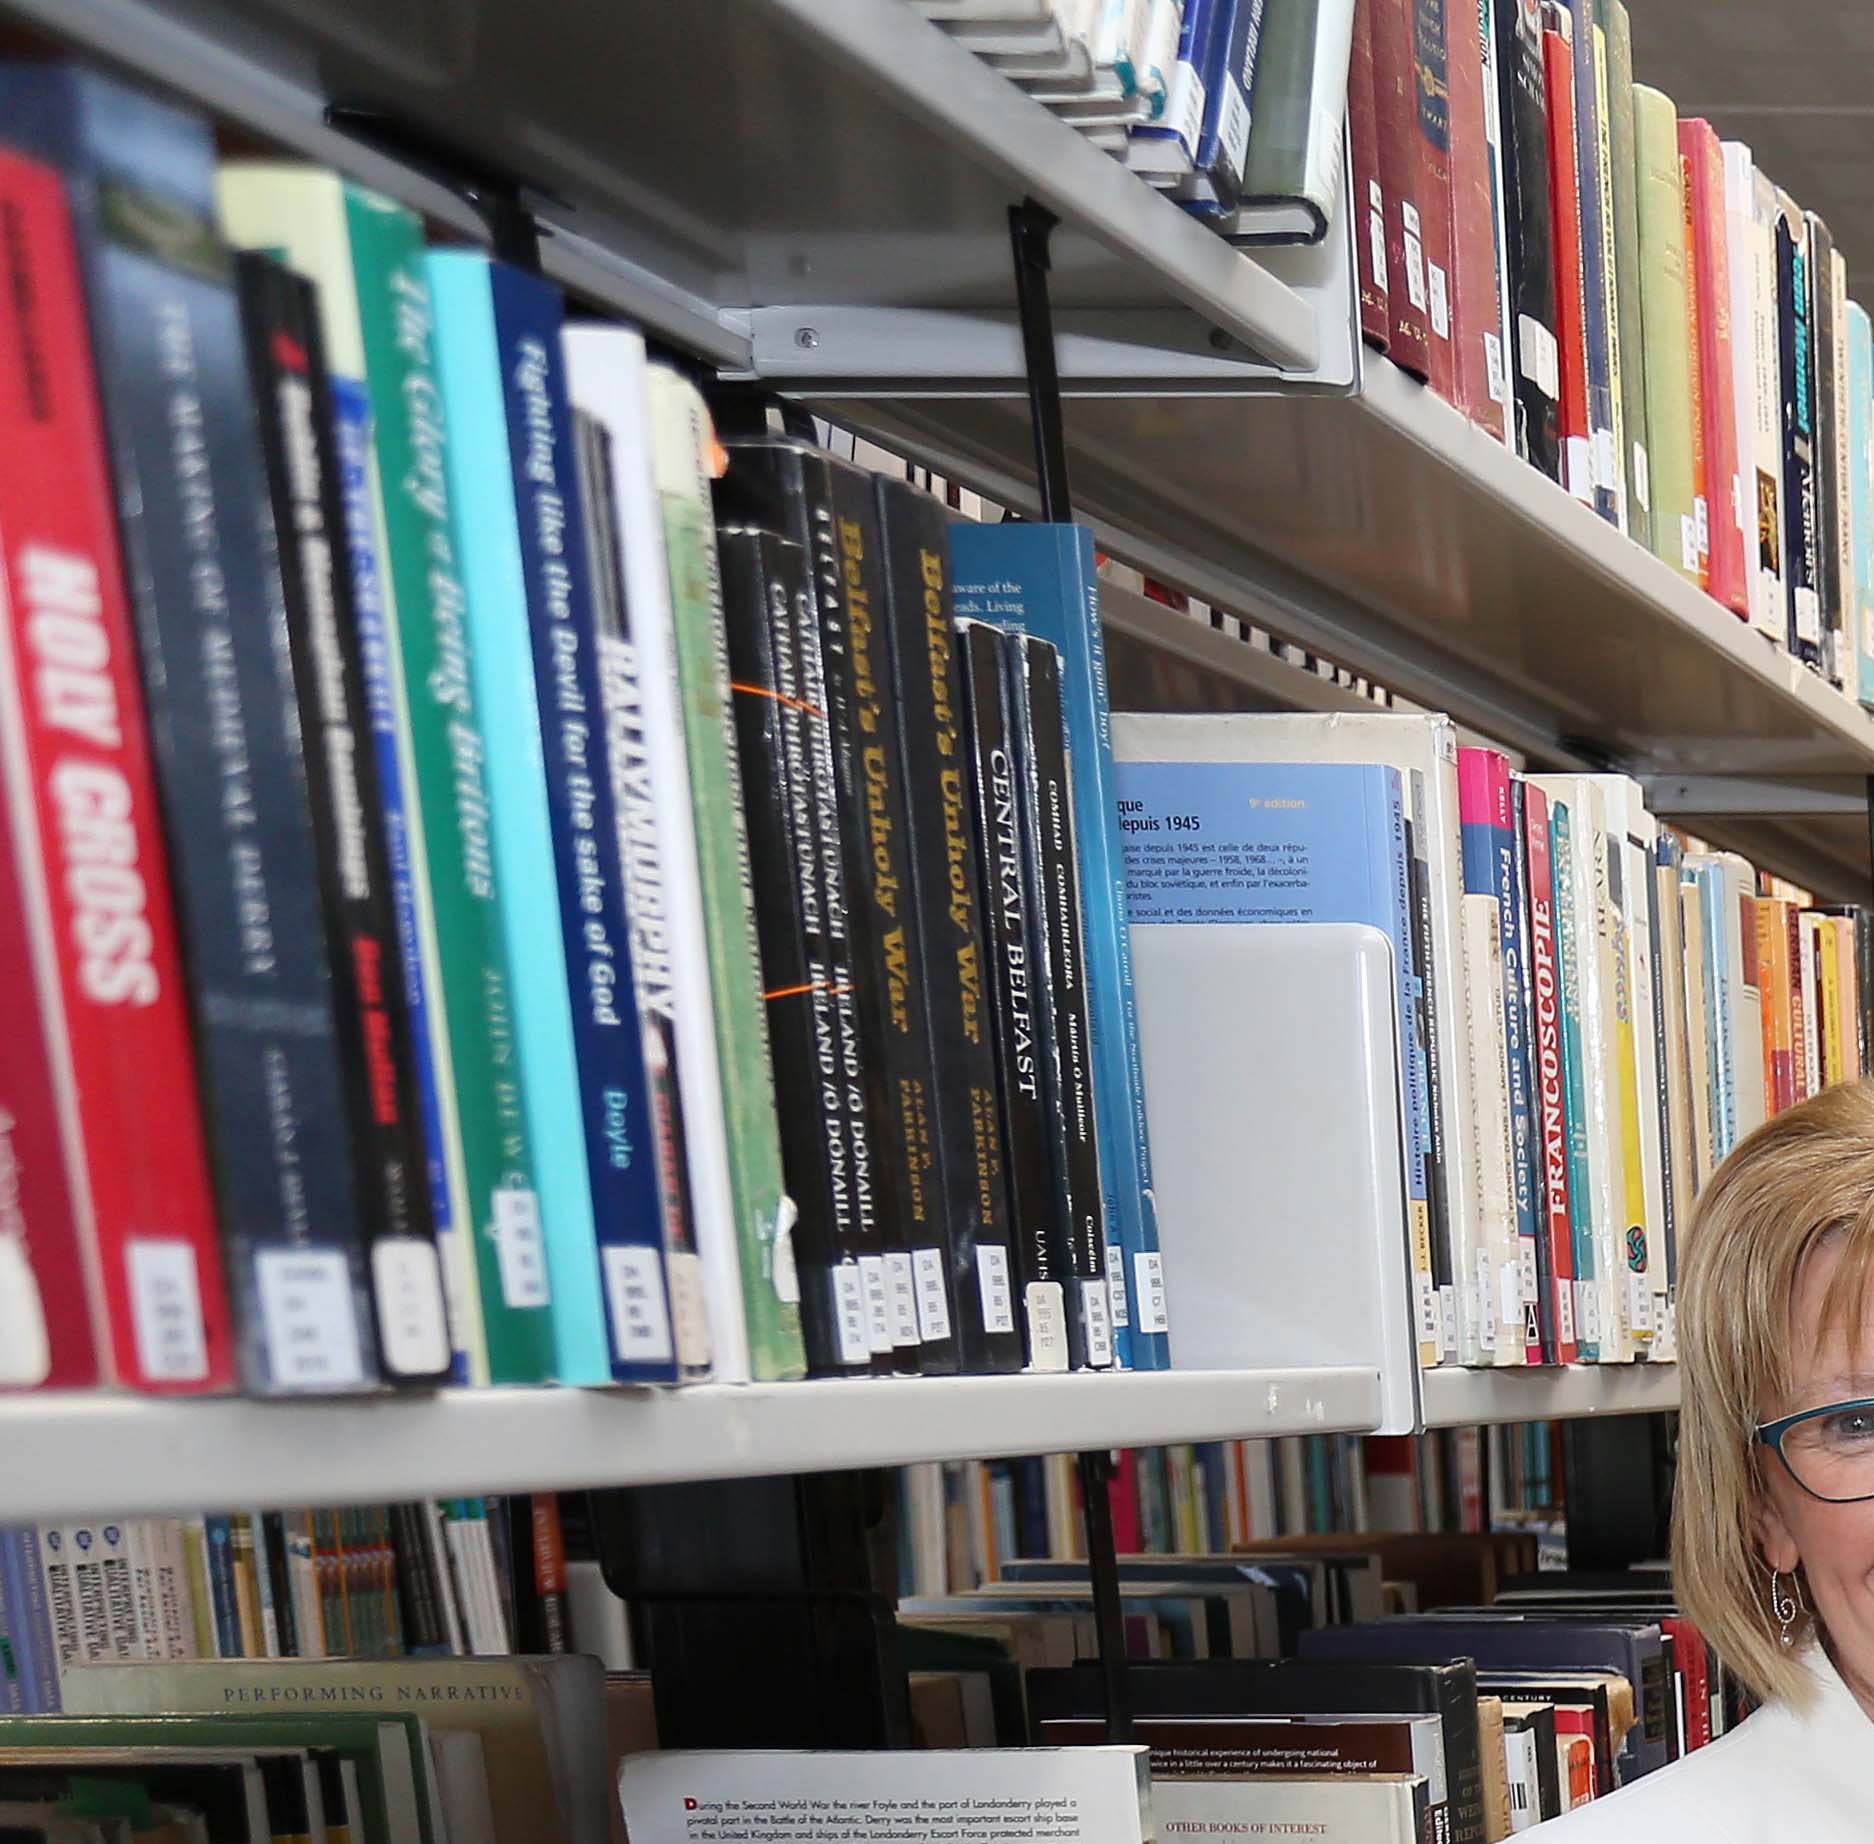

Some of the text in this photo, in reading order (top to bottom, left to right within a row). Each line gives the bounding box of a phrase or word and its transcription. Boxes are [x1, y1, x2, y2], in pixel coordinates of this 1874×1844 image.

[1800, 469, 1815, 585] Memoirs
[512, 341, 621, 1027] Fighting like the Devil for the sake of God
[17, 544, 160, 1005] HOLY CROSS
[839, 515, 910, 1034] Belfast's Unholy War
[919, 548, 981, 1043] Belfast's Unholy War
[1165, 817, 1200, 830] 1945
[1497, 786, 1508, 824] KELLY
[989, 750, 1037, 1100] CENTRAL BELFAST
[1500, 847, 1531, 1213] French Culture and Society
[1533, 898, 1567, 1217] FRANCOSCOPIE
[1792, 995, 1807, 1090] CULTURAL
[601, 1089, 634, 1169] Doyle
[899, 1078, 926, 1221] PARKINSON
[223, 1685, 525, 1703] PERFORMING NARRATIVE
[1166, 1822, 1327, 1834] OTHER BOOKS OF INTEREST
